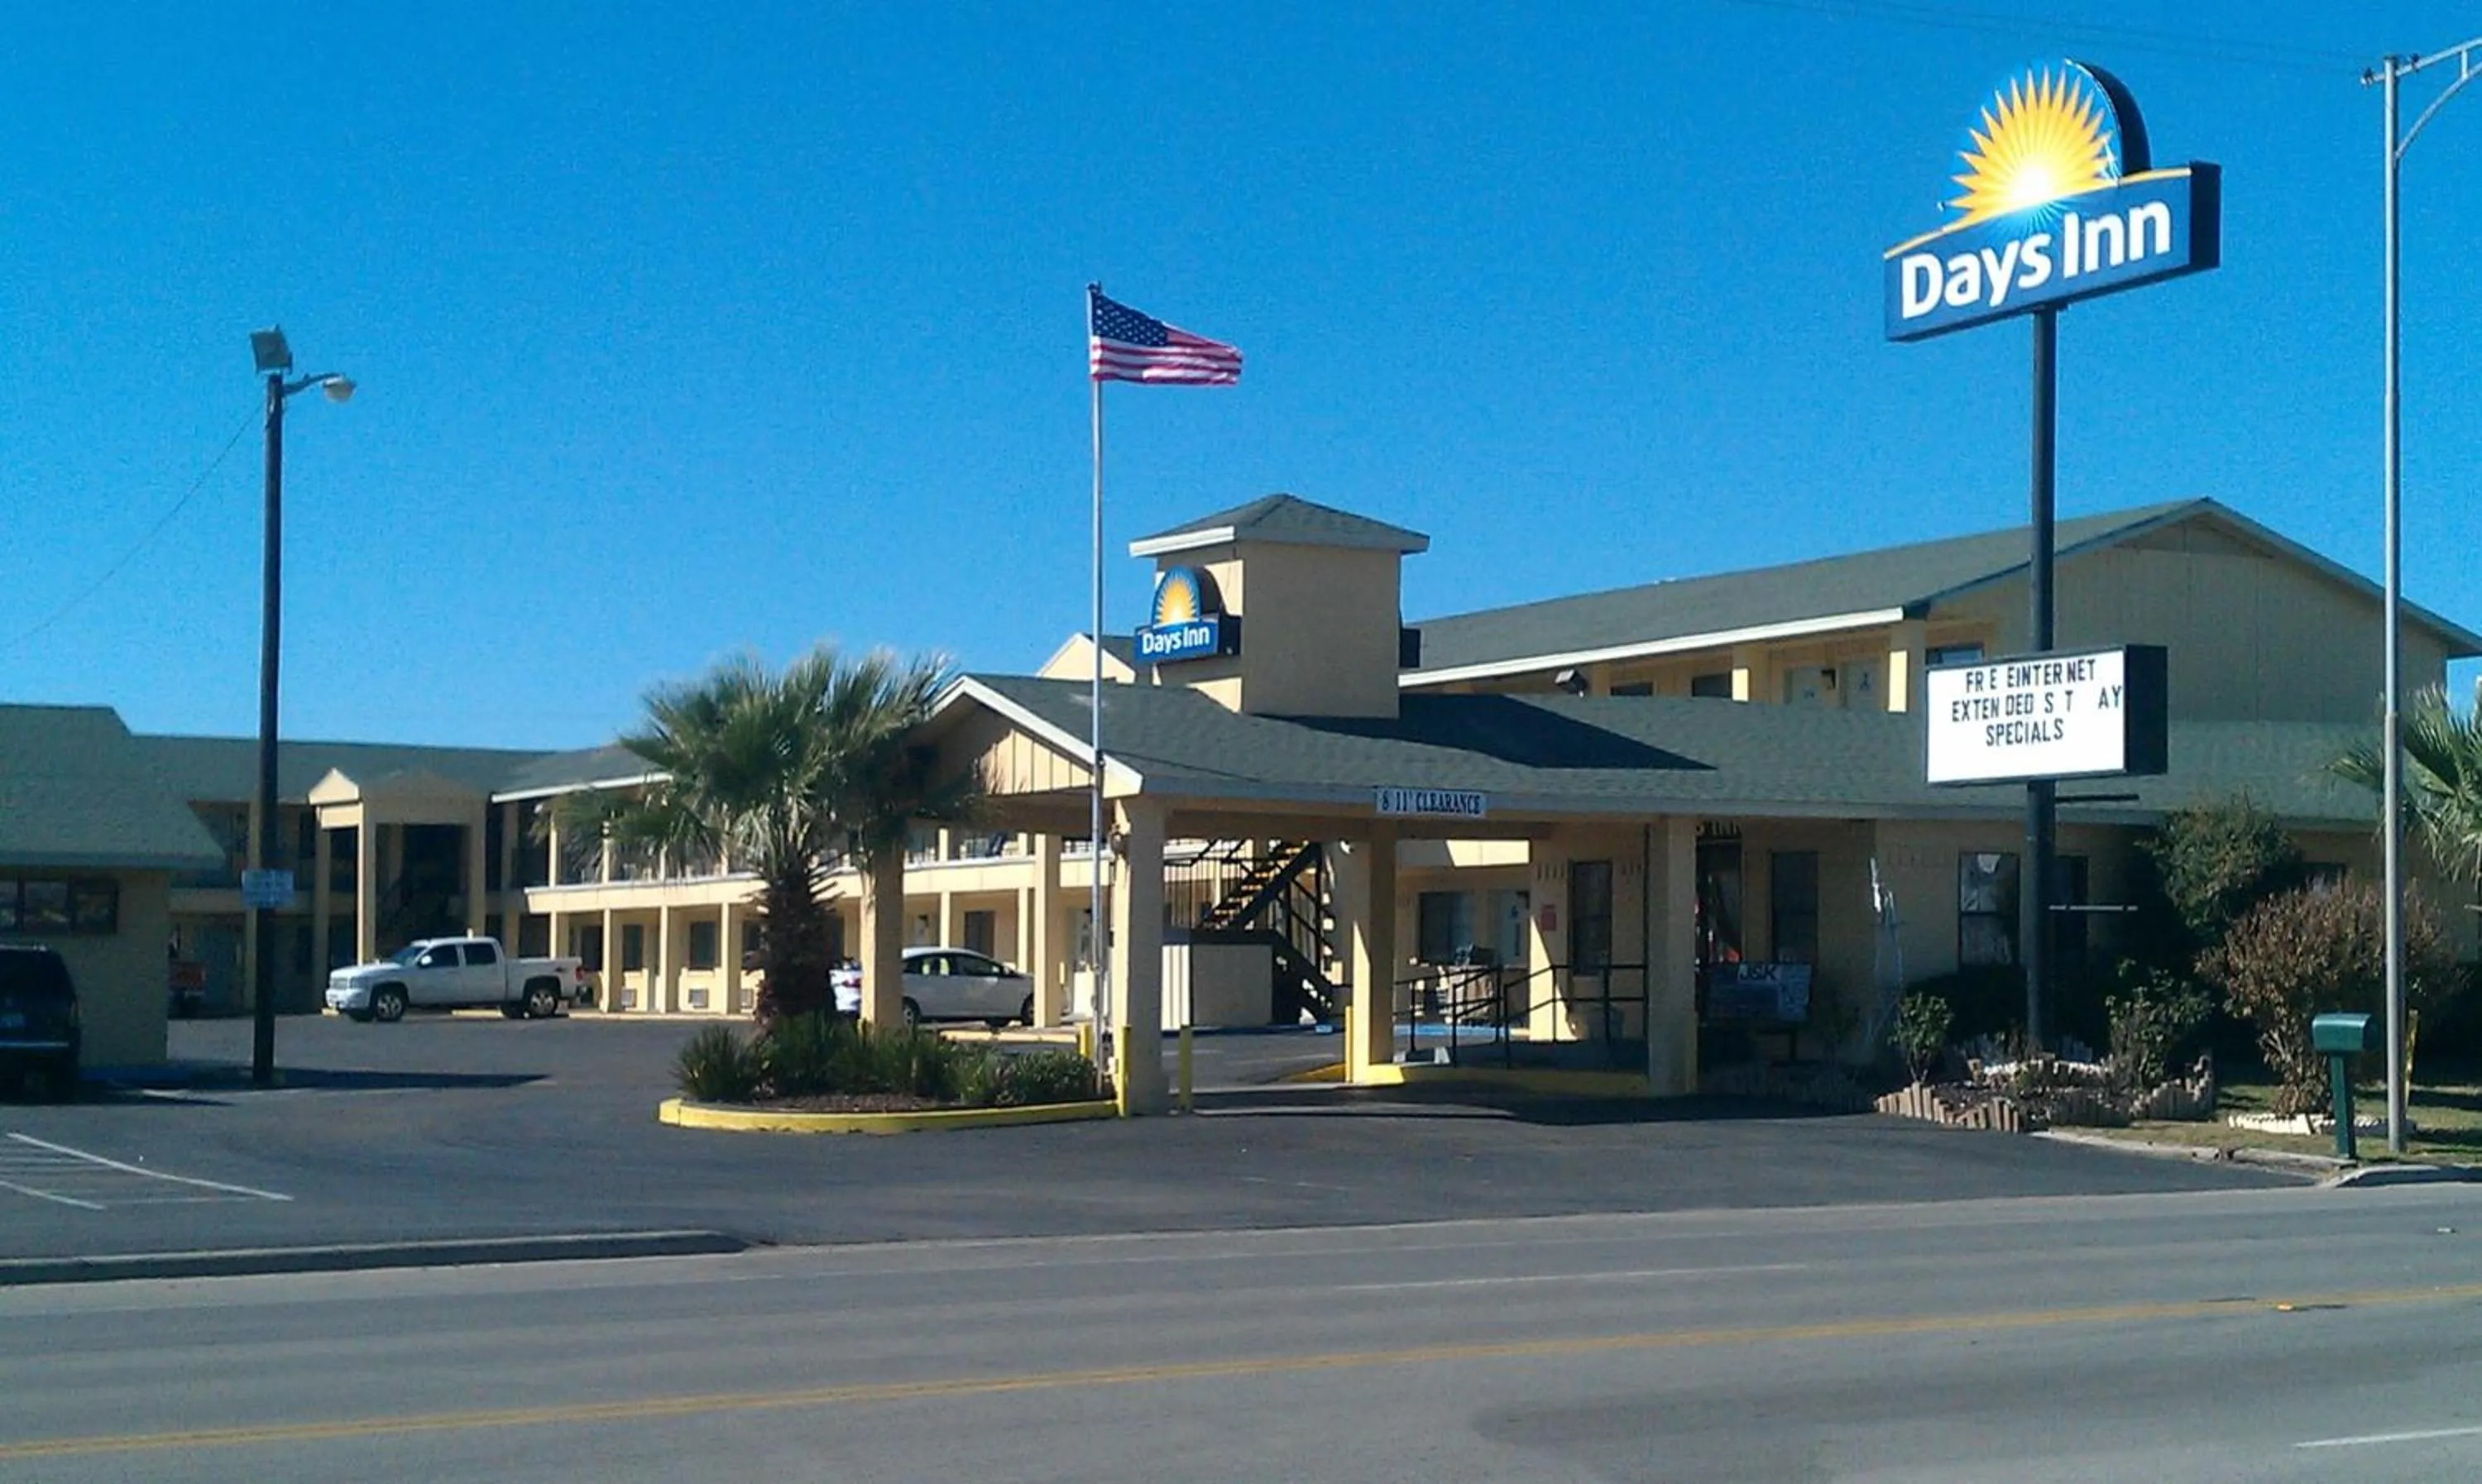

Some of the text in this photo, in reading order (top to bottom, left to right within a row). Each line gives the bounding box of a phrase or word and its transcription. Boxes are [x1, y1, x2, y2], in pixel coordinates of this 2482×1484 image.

[1901, 200, 2171, 318] Days Inn
[1142, 626, 1210, 654] Days Inn
[1986, 718, 2064, 746] SPECIALS
[1416, 792, 1481, 815] CLEARANCE
